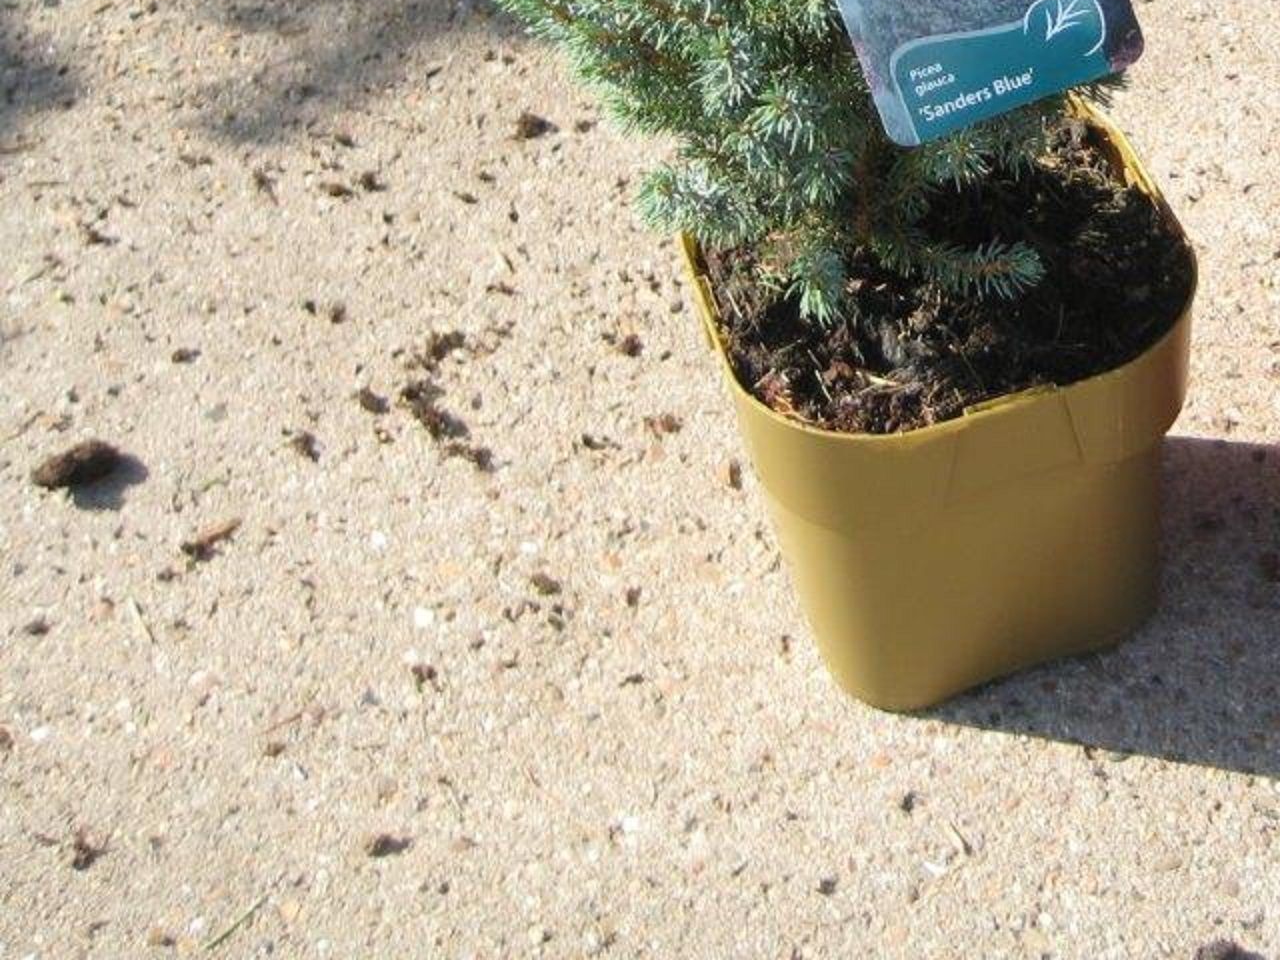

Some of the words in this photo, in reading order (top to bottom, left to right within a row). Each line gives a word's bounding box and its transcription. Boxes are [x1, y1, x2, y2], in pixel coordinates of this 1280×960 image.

[909, 62, 943, 81] Picea
[915, 73, 956, 97] glauca
[919, 87, 992, 121] 'Sanders
[992, 67, 1034, 96] Blue'
